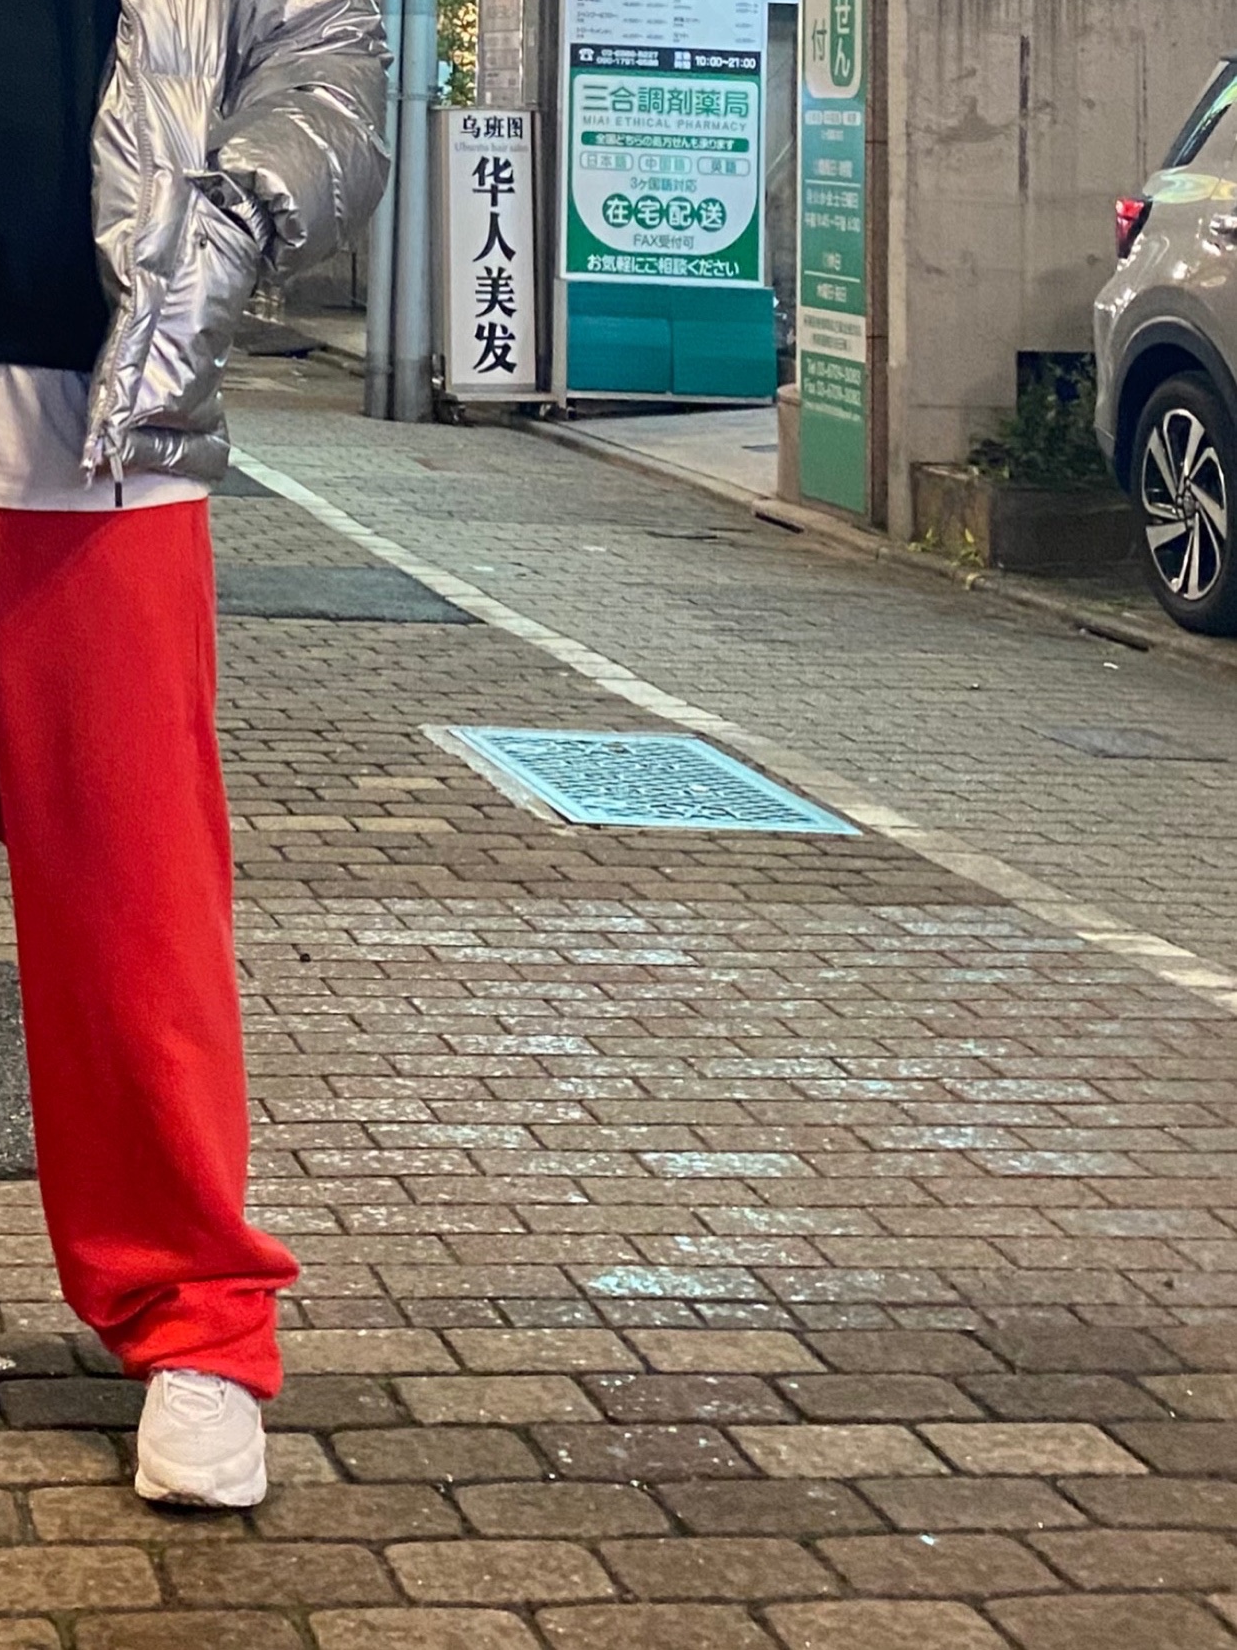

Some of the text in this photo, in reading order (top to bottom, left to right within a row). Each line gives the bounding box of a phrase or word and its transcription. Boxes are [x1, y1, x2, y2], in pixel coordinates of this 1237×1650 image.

[583, 86, 749, 119] 三合調剤薬局
[460, 115, 523, 139] 乌班图
[583, 115, 747, 132] MIAI ETHICAL PHARMACY
[587, 153, 627, 168] 日本語
[605, 198, 723, 228] 在宅配送
[633, 234, 695, 250] FAX受付可
[472, 156, 517, 375] 华人美发
[587, 254, 740, 278] お気軽にご相談ください
